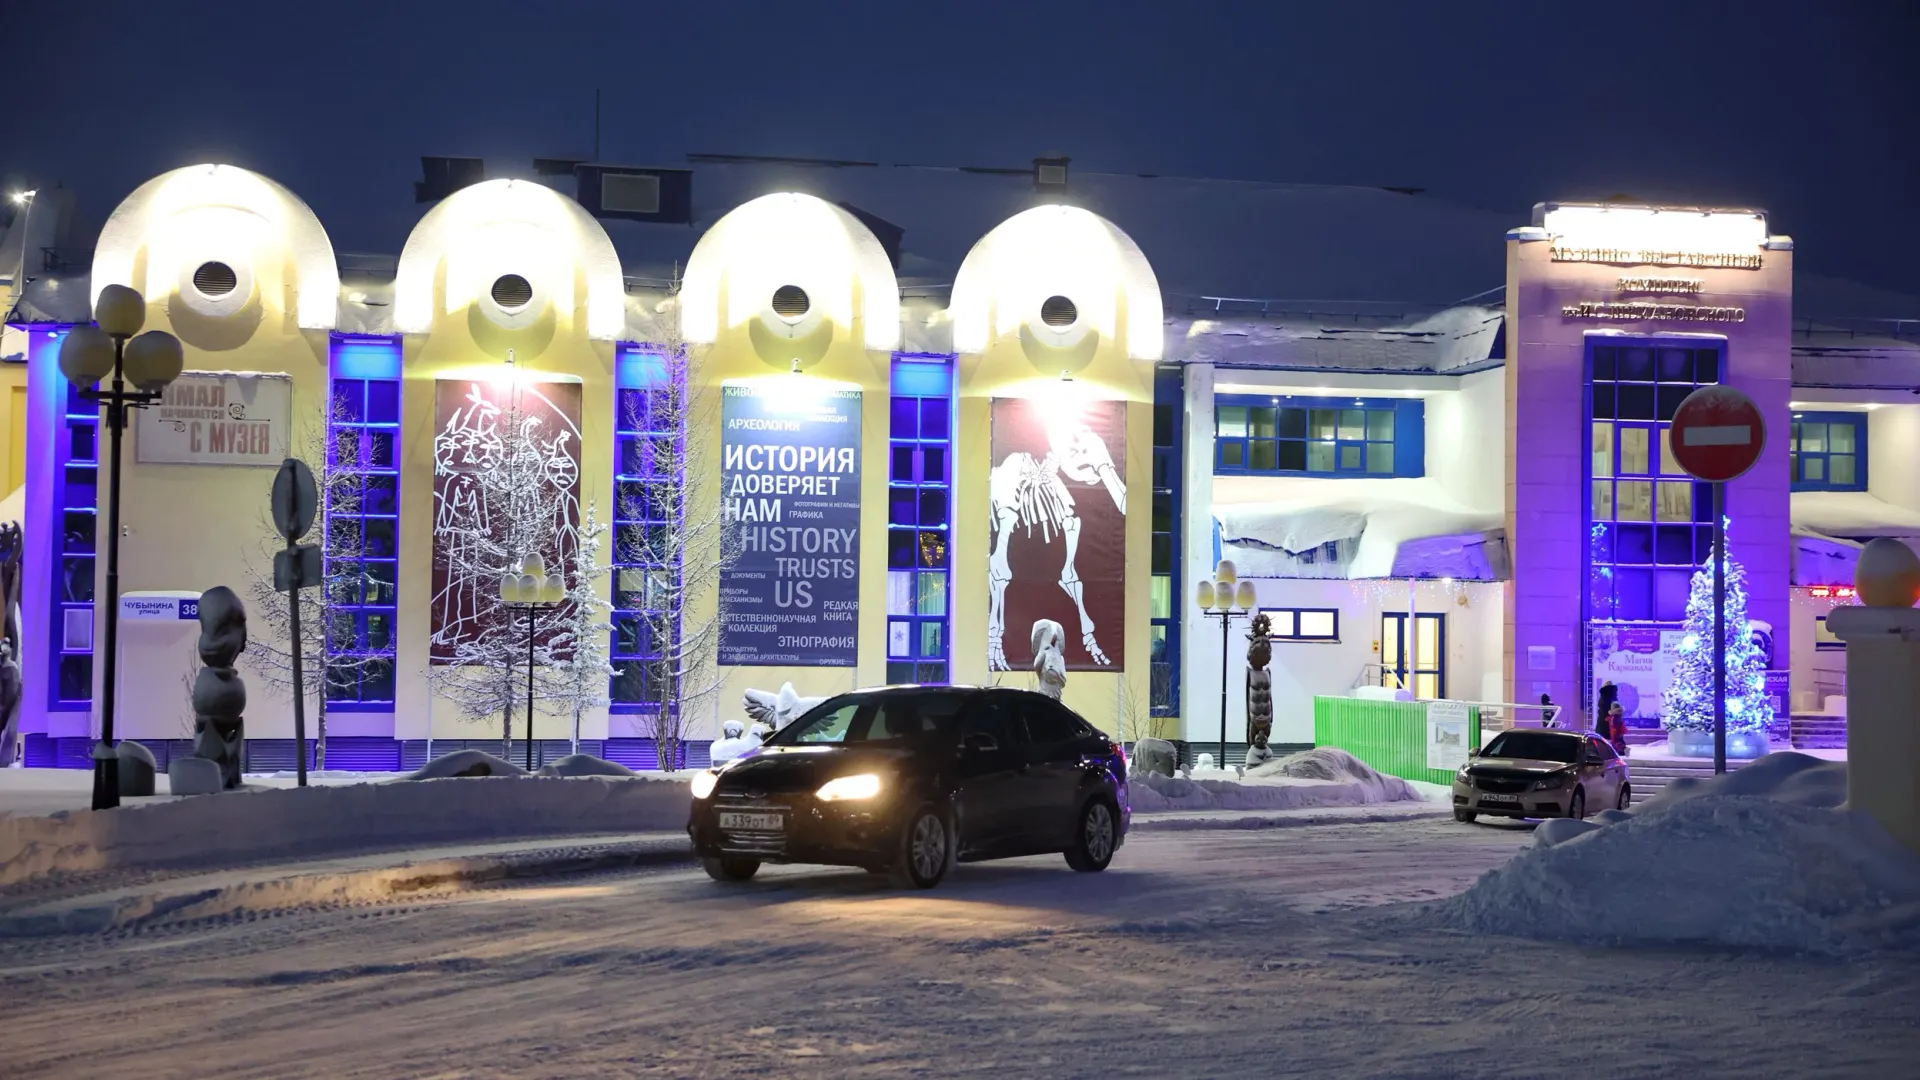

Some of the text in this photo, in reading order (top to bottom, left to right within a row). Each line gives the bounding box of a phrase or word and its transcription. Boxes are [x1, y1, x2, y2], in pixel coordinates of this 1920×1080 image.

[728, 418, 800, 431] АРХЕОЛОГИЯ
[189, 421, 270, 454] С МУЗЕЯ
[725, 444, 854, 473] ИСТОРИЯ
[730, 474, 840, 496] ДОВЕРЯЕТ
[724, 498, 781, 522] НАМ
[789, 510, 824, 519] ГРАФИКА
[742, 526, 857, 554] HISTORY
[775, 557, 855, 579] TRUSTS
[775, 580, 813, 608] US
[124, 602, 174, 610] ЧУБЫНИНА
[182, 604, 198, 615] 38
[823, 601, 858, 611] РЕДКАЯ
[823, 612, 853, 621] КНИГА
[728, 624, 777, 633] КОЛЛЕКЦИЯ
[777, 635, 855, 648] ЭТНОГРАФИЯ
[1625, 654, 1653, 664] Магия
[1608, 661, 1652, 673] Карнавала
